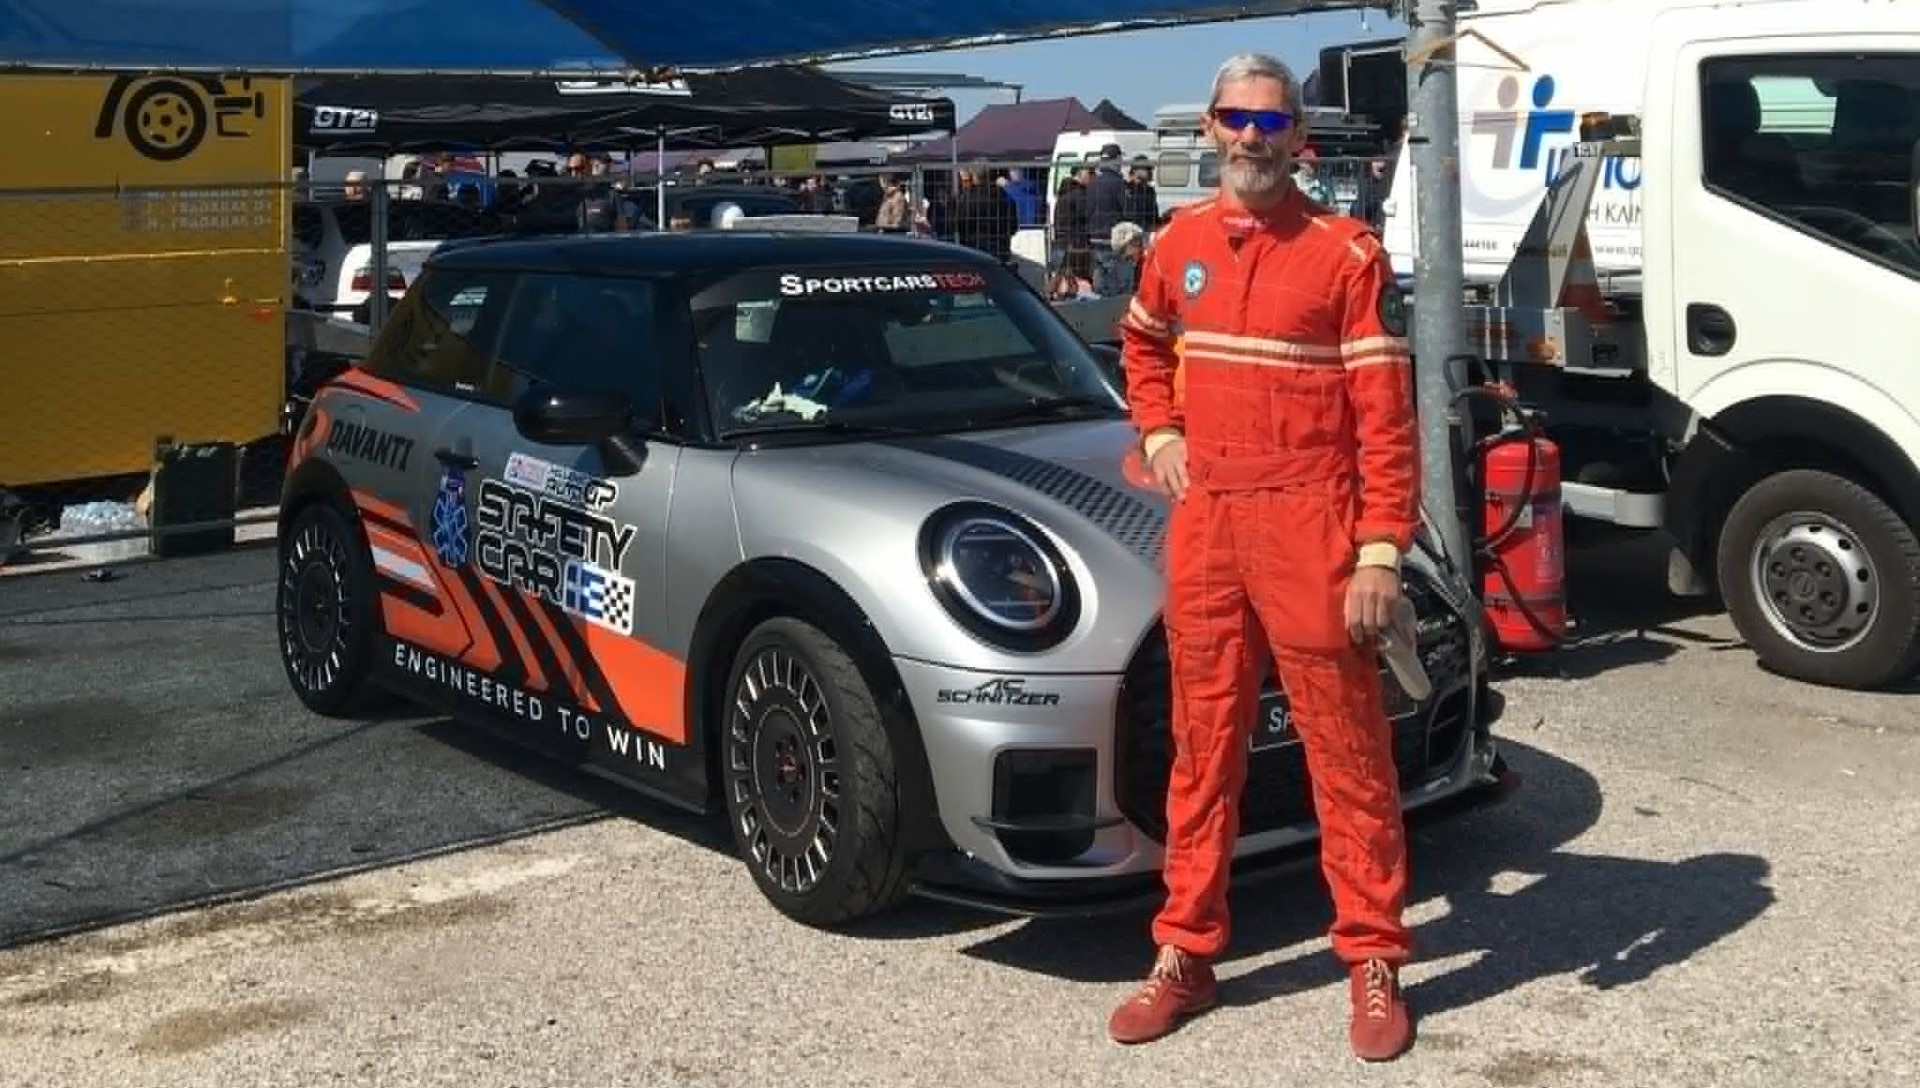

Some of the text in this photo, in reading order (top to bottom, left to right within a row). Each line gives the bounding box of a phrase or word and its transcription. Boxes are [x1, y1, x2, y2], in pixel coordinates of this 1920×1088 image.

[326, 418, 415, 474] DAVANTI
[479, 479, 638, 577] SAFETY
[476, 530, 565, 605] CAR
[393, 642, 666, 771] ENGINEERED TO WIN
[936, 687, 1060, 706] SCHNITZER
